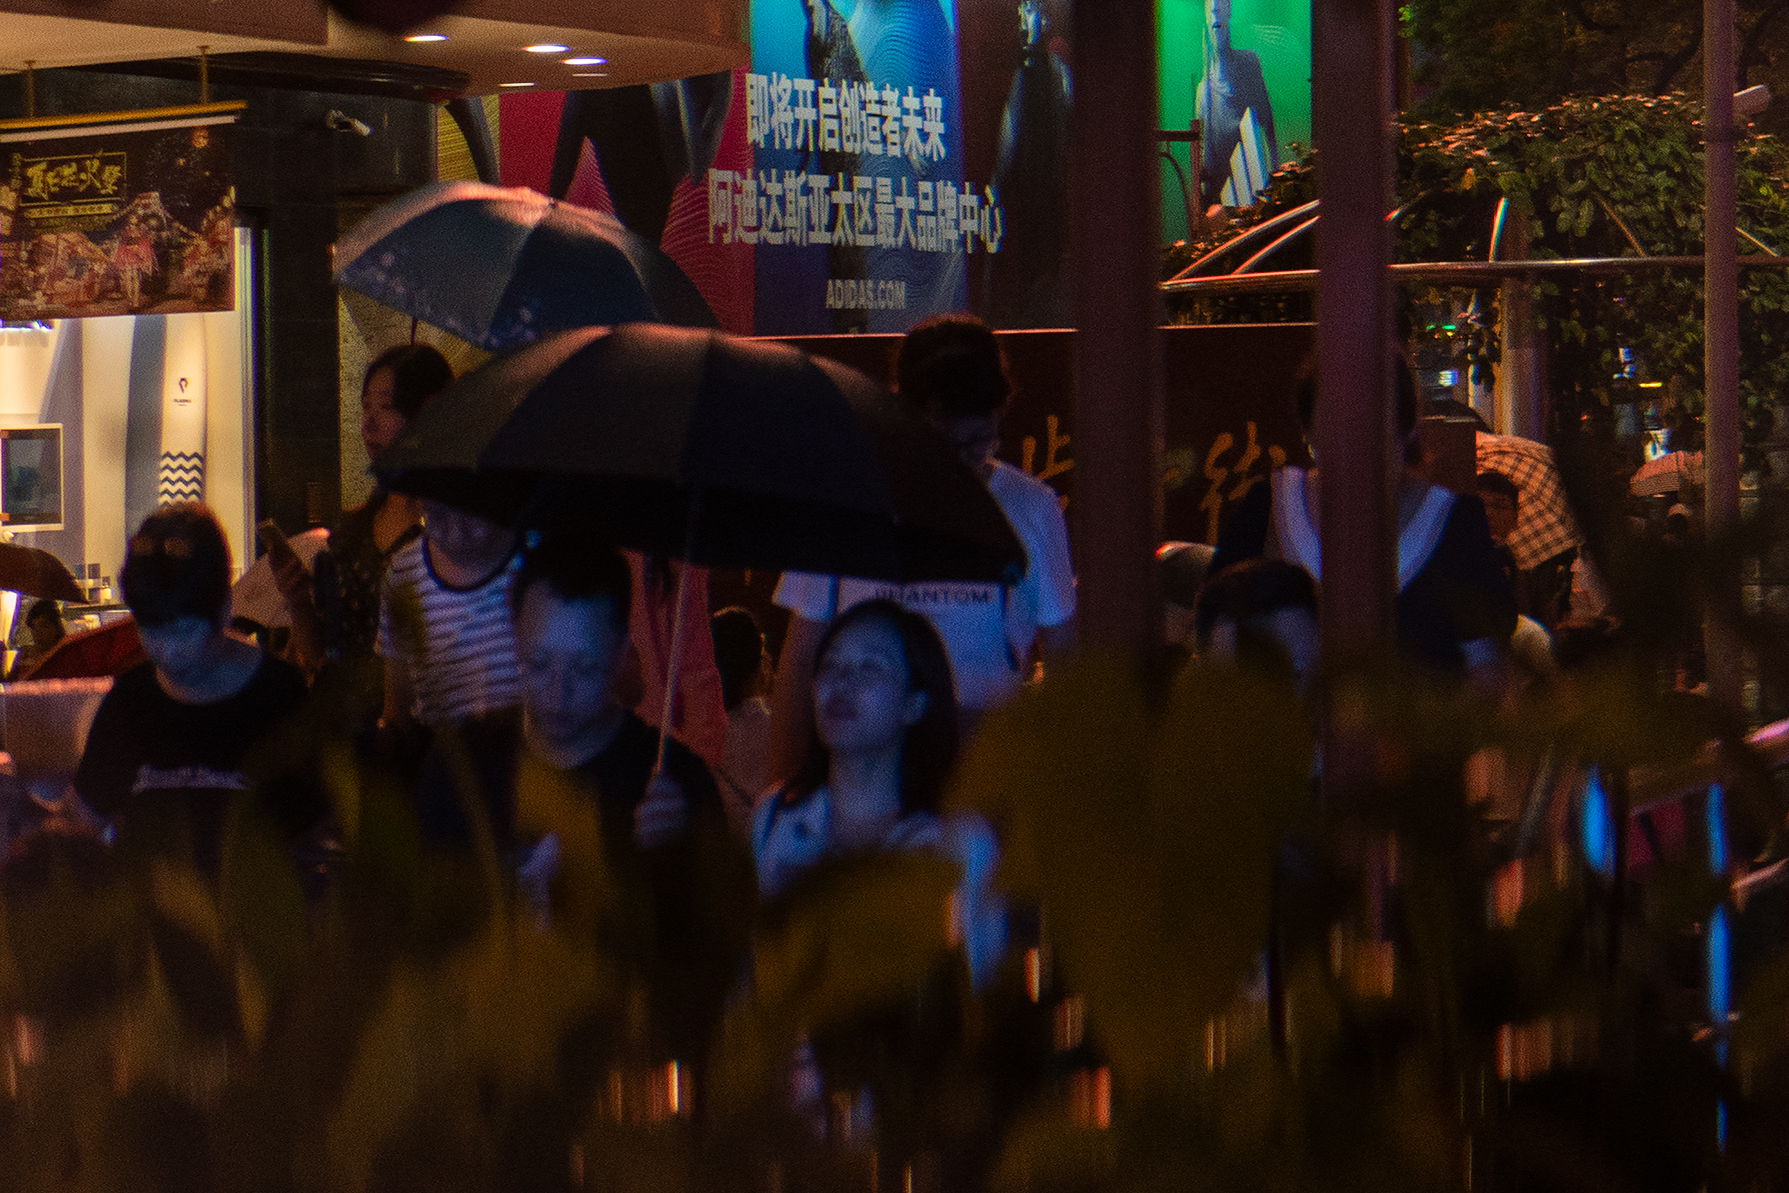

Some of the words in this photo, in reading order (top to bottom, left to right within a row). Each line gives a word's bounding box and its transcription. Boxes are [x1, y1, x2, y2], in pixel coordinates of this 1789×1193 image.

[746, 72, 948, 161] 即将开启创造者未来
[708, 167, 1005, 254] 阿迪达斯亚太区最大品牌中心
[826, 278, 906, 310] ADIDAS.COM
